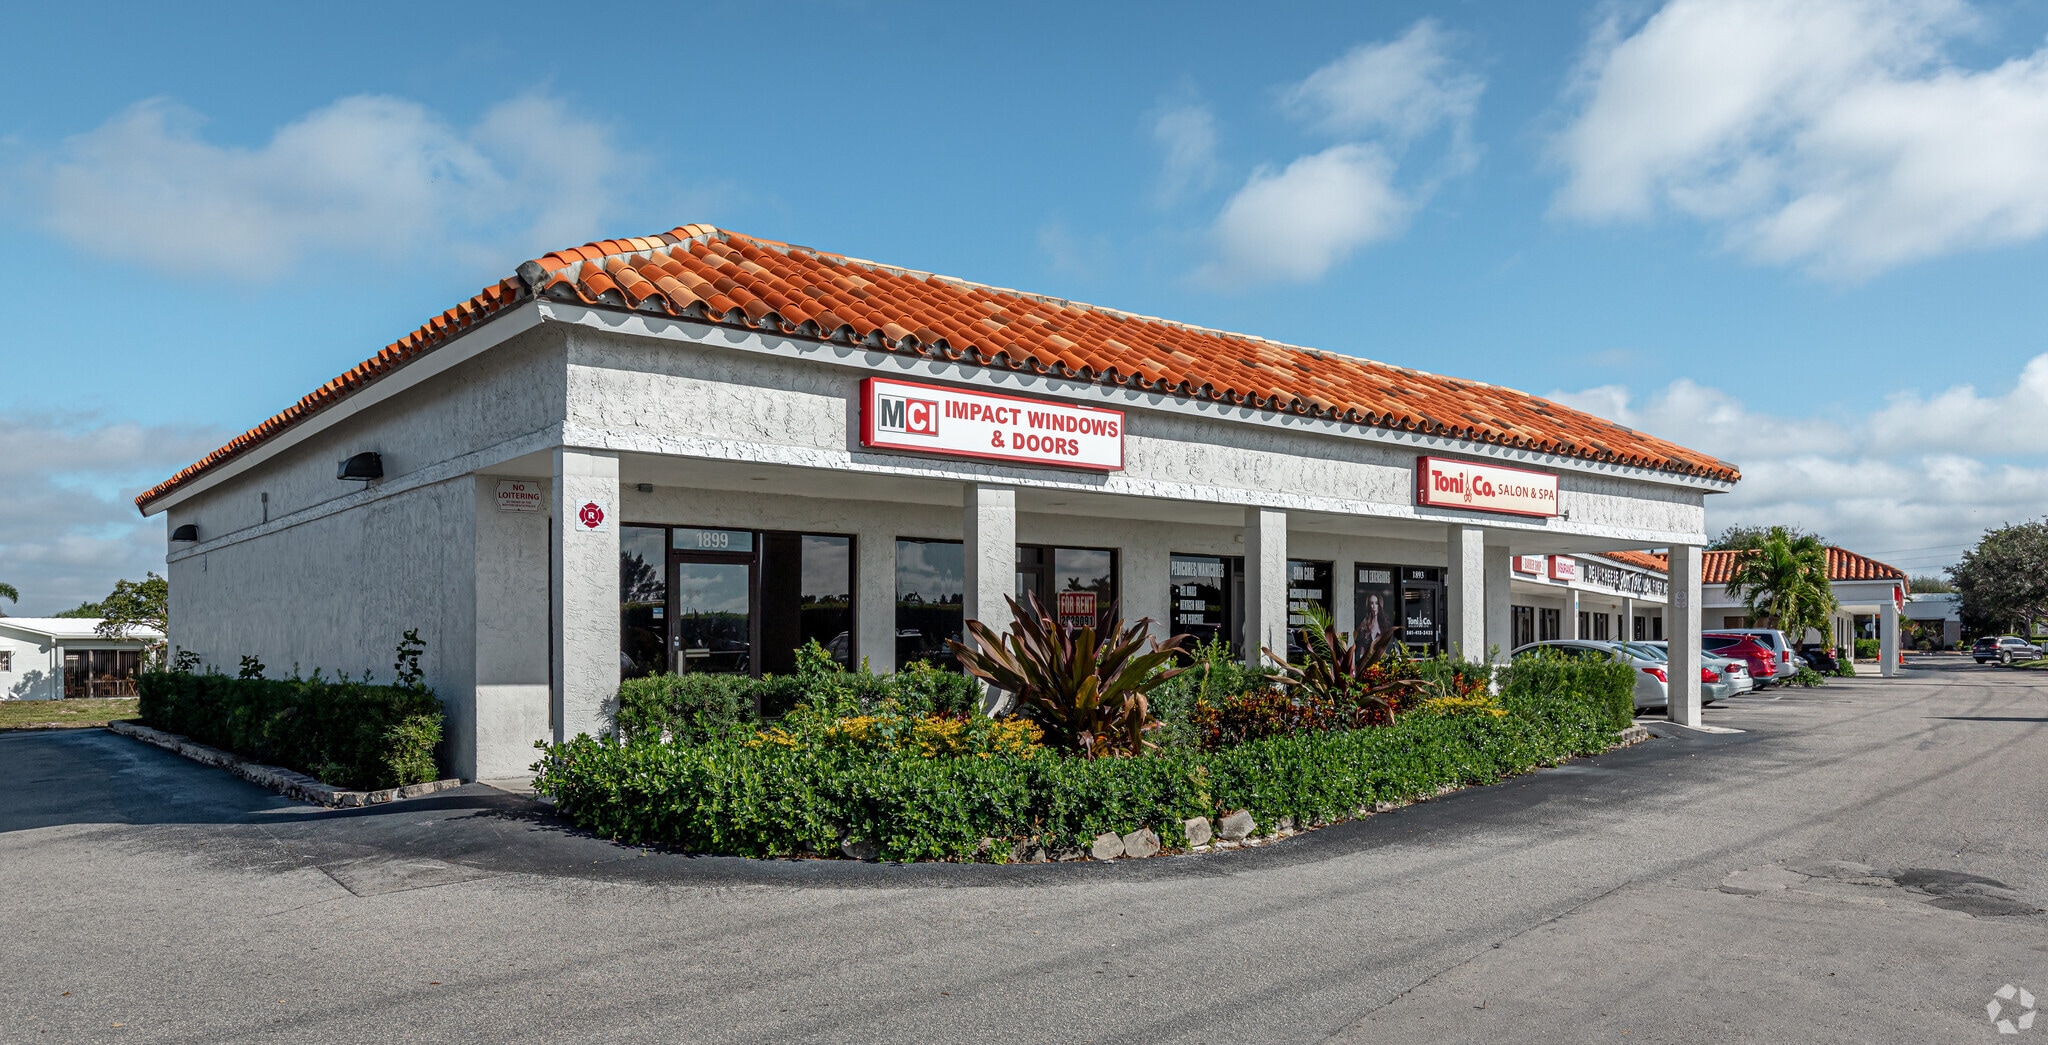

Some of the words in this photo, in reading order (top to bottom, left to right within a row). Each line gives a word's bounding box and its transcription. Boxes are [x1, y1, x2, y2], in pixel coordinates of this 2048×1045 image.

[881, 398, 936, 433] MCI
[945, 400, 1021, 426] IMPACT
[1028, 411, 1119, 438] WINDOWS
[991, 430, 1005, 448] &
[1013, 432, 1079, 456] DOORS
[498, 492, 540, 500] LOITERING
[1432, 470, 1463, 494] Toni
[1472, 475, 1496, 498] Co.
[1498, 484, 1529, 498] SALON
[1531, 488, 1537, 499] &
[1539, 488, 1555, 501] SPA
[697, 532, 729, 548] 1899
[1412, 571, 1425, 579] 1893
[1061, 596, 1074, 613] FOR
[1076, 596, 1093, 613] RENT
